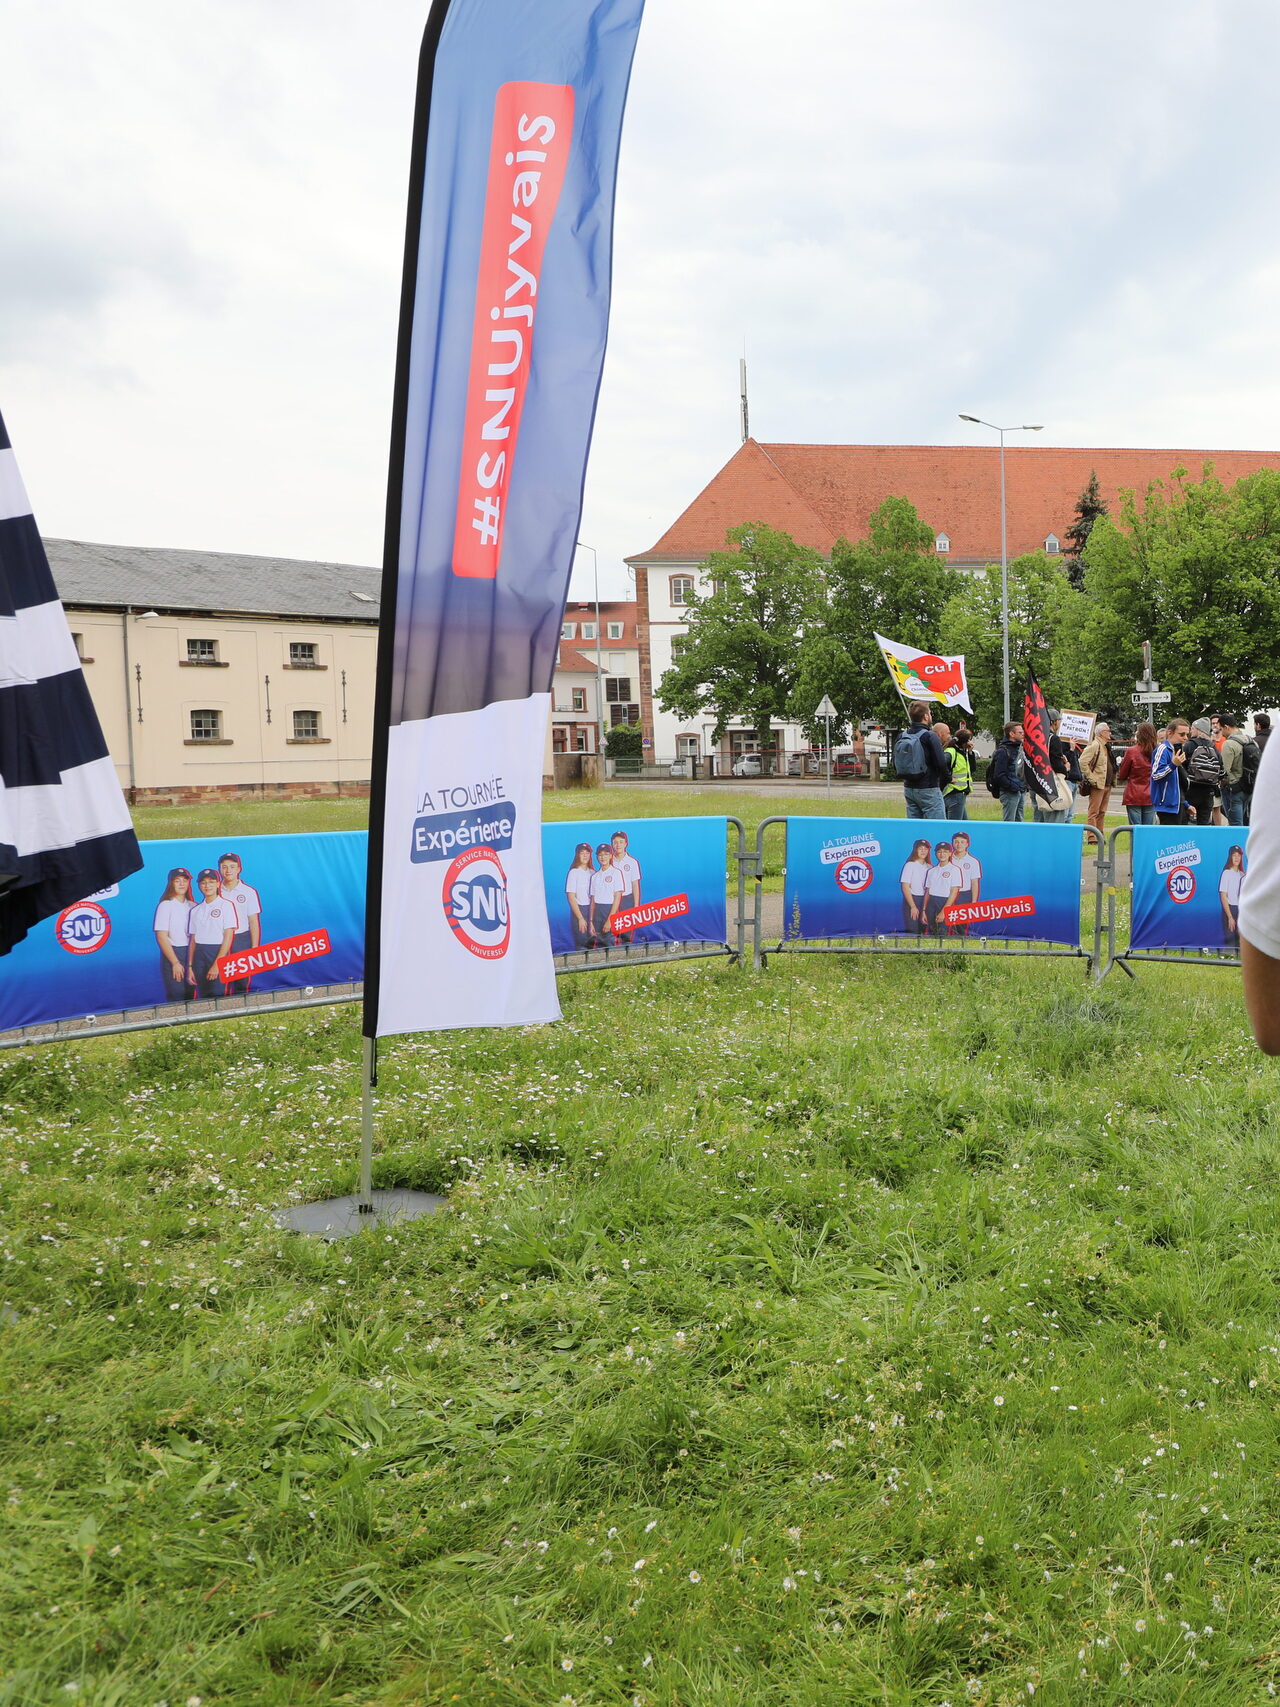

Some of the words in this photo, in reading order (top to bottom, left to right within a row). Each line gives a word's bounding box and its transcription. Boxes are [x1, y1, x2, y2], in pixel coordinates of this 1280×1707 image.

[471, 113, 556, 546] #SNUjyvais
[924, 662, 954, 675] CGT
[416, 792, 435, 814] LA
[415, 817, 512, 856] Expérience
[822, 839, 834, 848] LA
[835, 832, 875, 846] TOURNÉE
[824, 845, 876, 861] Expérience
[1156, 849, 1165, 858] LA
[1165, 840, 1196, 855] TOURNÉE
[455, 850, 482, 869] SERVICE
[1158, 854, 1198, 870] Expérience
[839, 868, 870, 881] SNU
[1170, 878, 1193, 891] SNU
[451, 882, 508, 924] SNU
[948, 900, 1031, 922] #SNUjyvais
[614, 899, 686, 931] #SNUjyvais
[61, 917, 106, 939] SNU
[223, 936, 327, 978] #SNUjyvais
